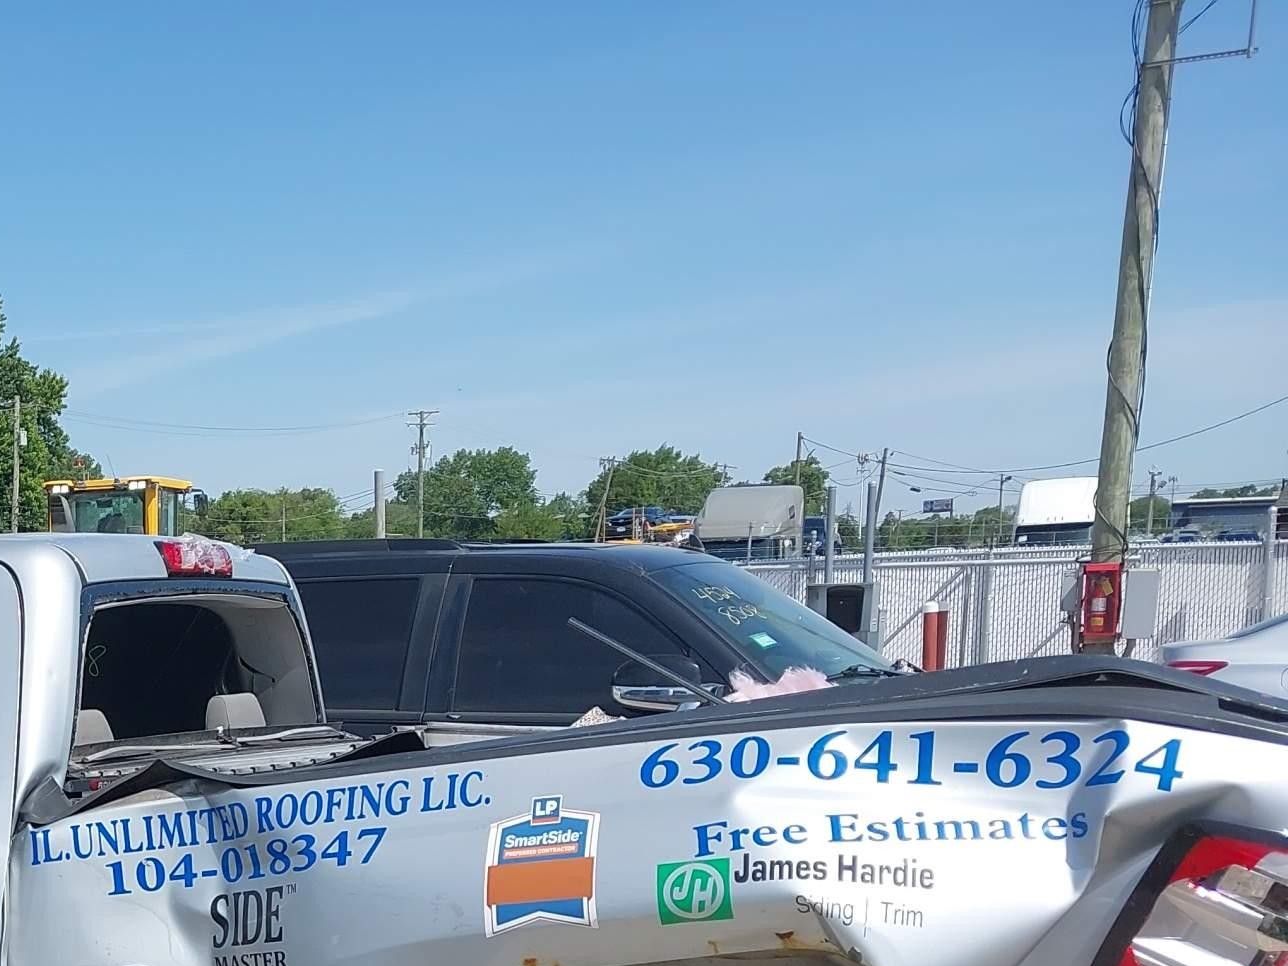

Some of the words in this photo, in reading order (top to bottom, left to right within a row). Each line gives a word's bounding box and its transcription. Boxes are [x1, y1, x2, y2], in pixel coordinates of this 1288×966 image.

[639, 728, 1184, 794] 630-641-6324
[256, 779, 412, 834] ROOFING
[420, 770, 492, 811] LIC.
[106, 827, 388, 897] 104-018347
[504, 829, 581, 848] SmartSide
[692, 819, 808, 858] Free
[824, 811, 1089, 846] Estimates
[734, 852, 828, 883] James
[837, 854, 935, 889] Hardie
[210, 885, 284, 949] SIDE
[795, 895, 855, 926] Siding
[880, 901, 924, 928] Trim
